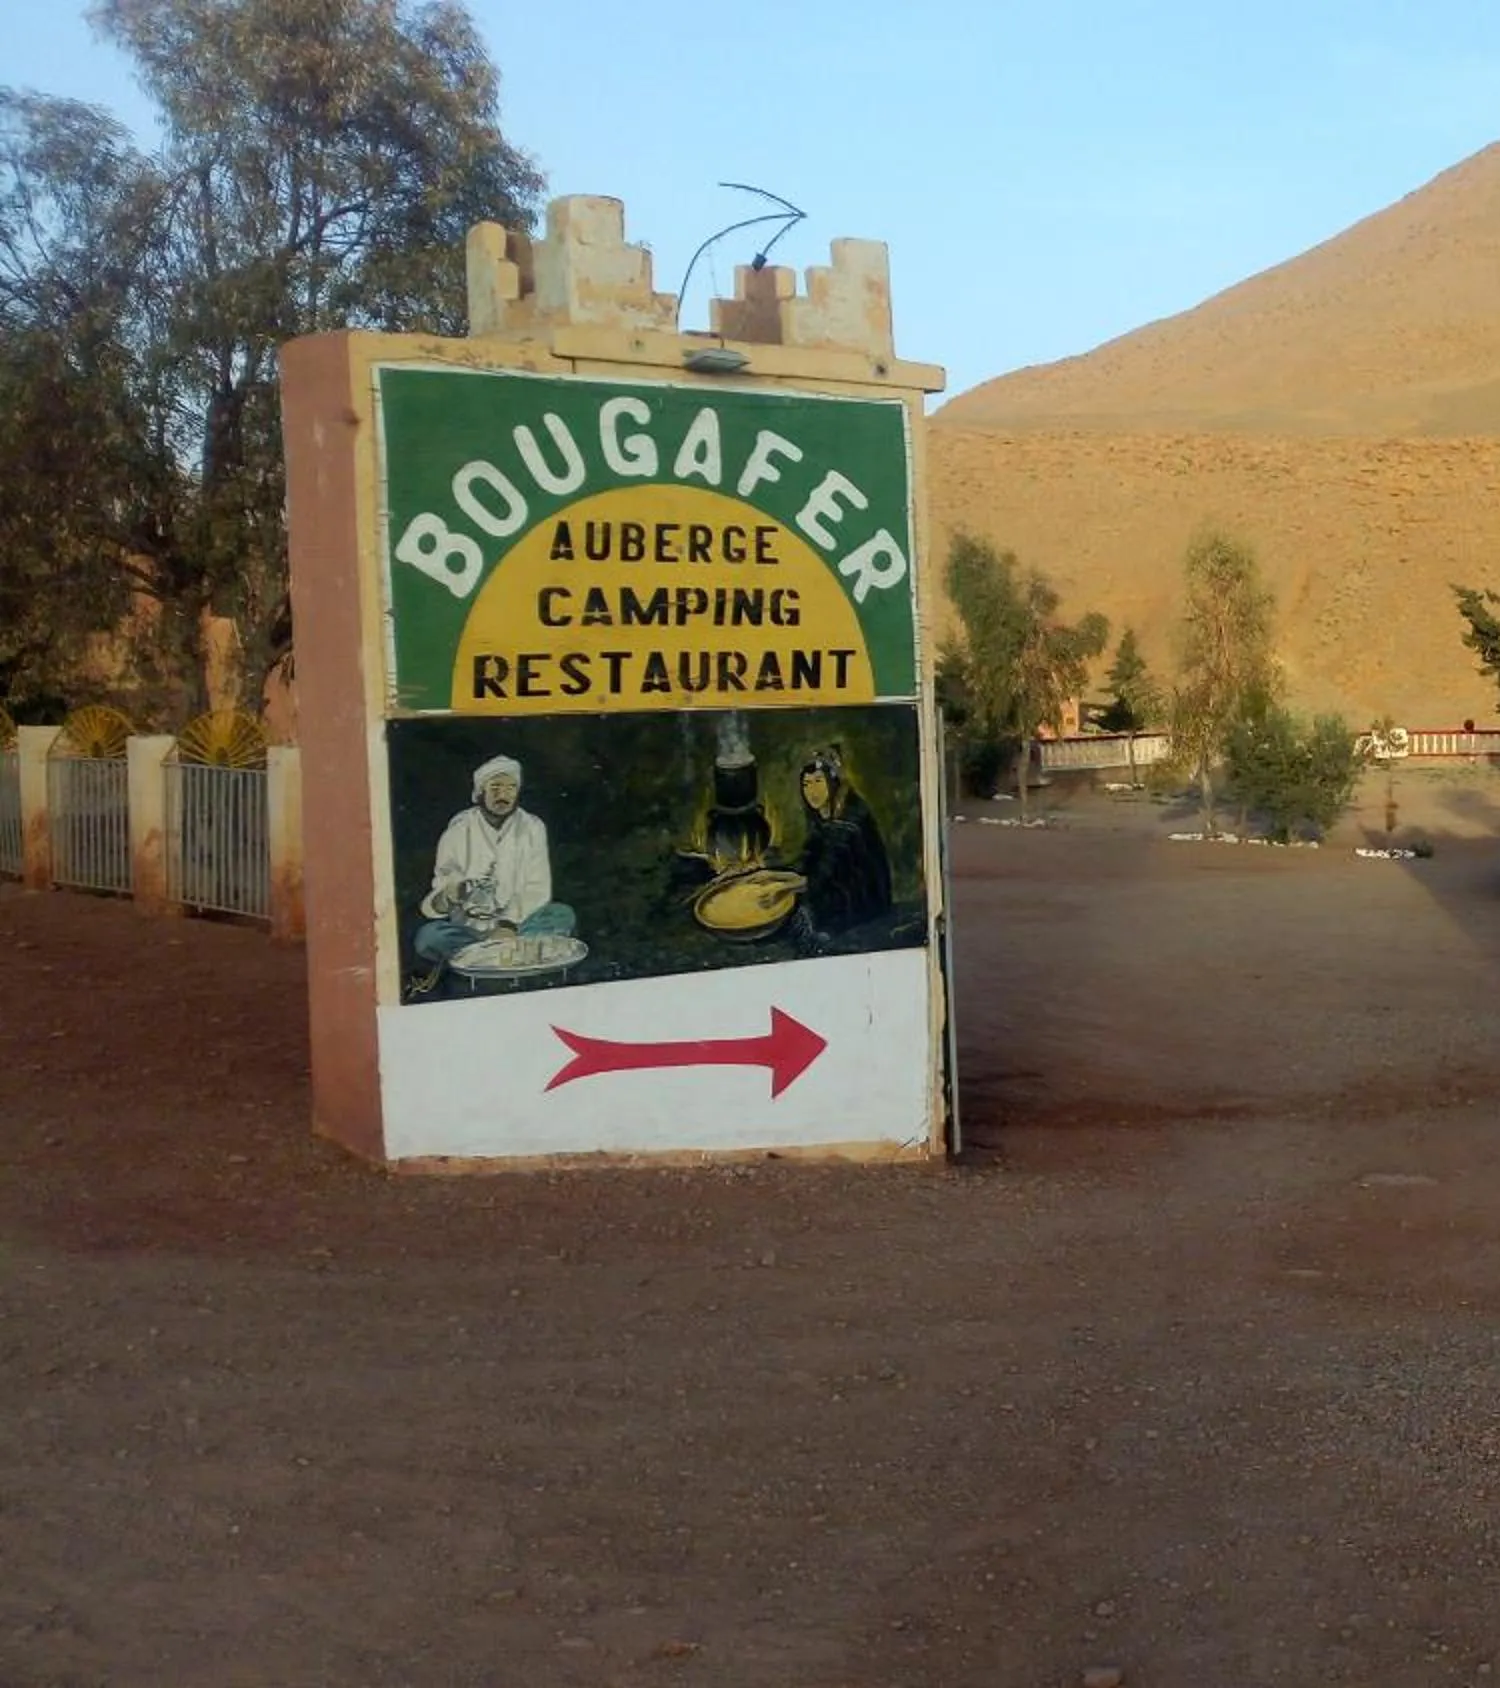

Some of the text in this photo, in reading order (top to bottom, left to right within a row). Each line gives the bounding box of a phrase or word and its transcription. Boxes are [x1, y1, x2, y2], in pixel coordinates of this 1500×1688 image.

[396, 397, 906, 604] BOUGAFER
[550, 521, 779, 564] AUBERGE
[538, 587, 801, 627] CAMPING
[472, 649, 857, 699] RESTAURANT
